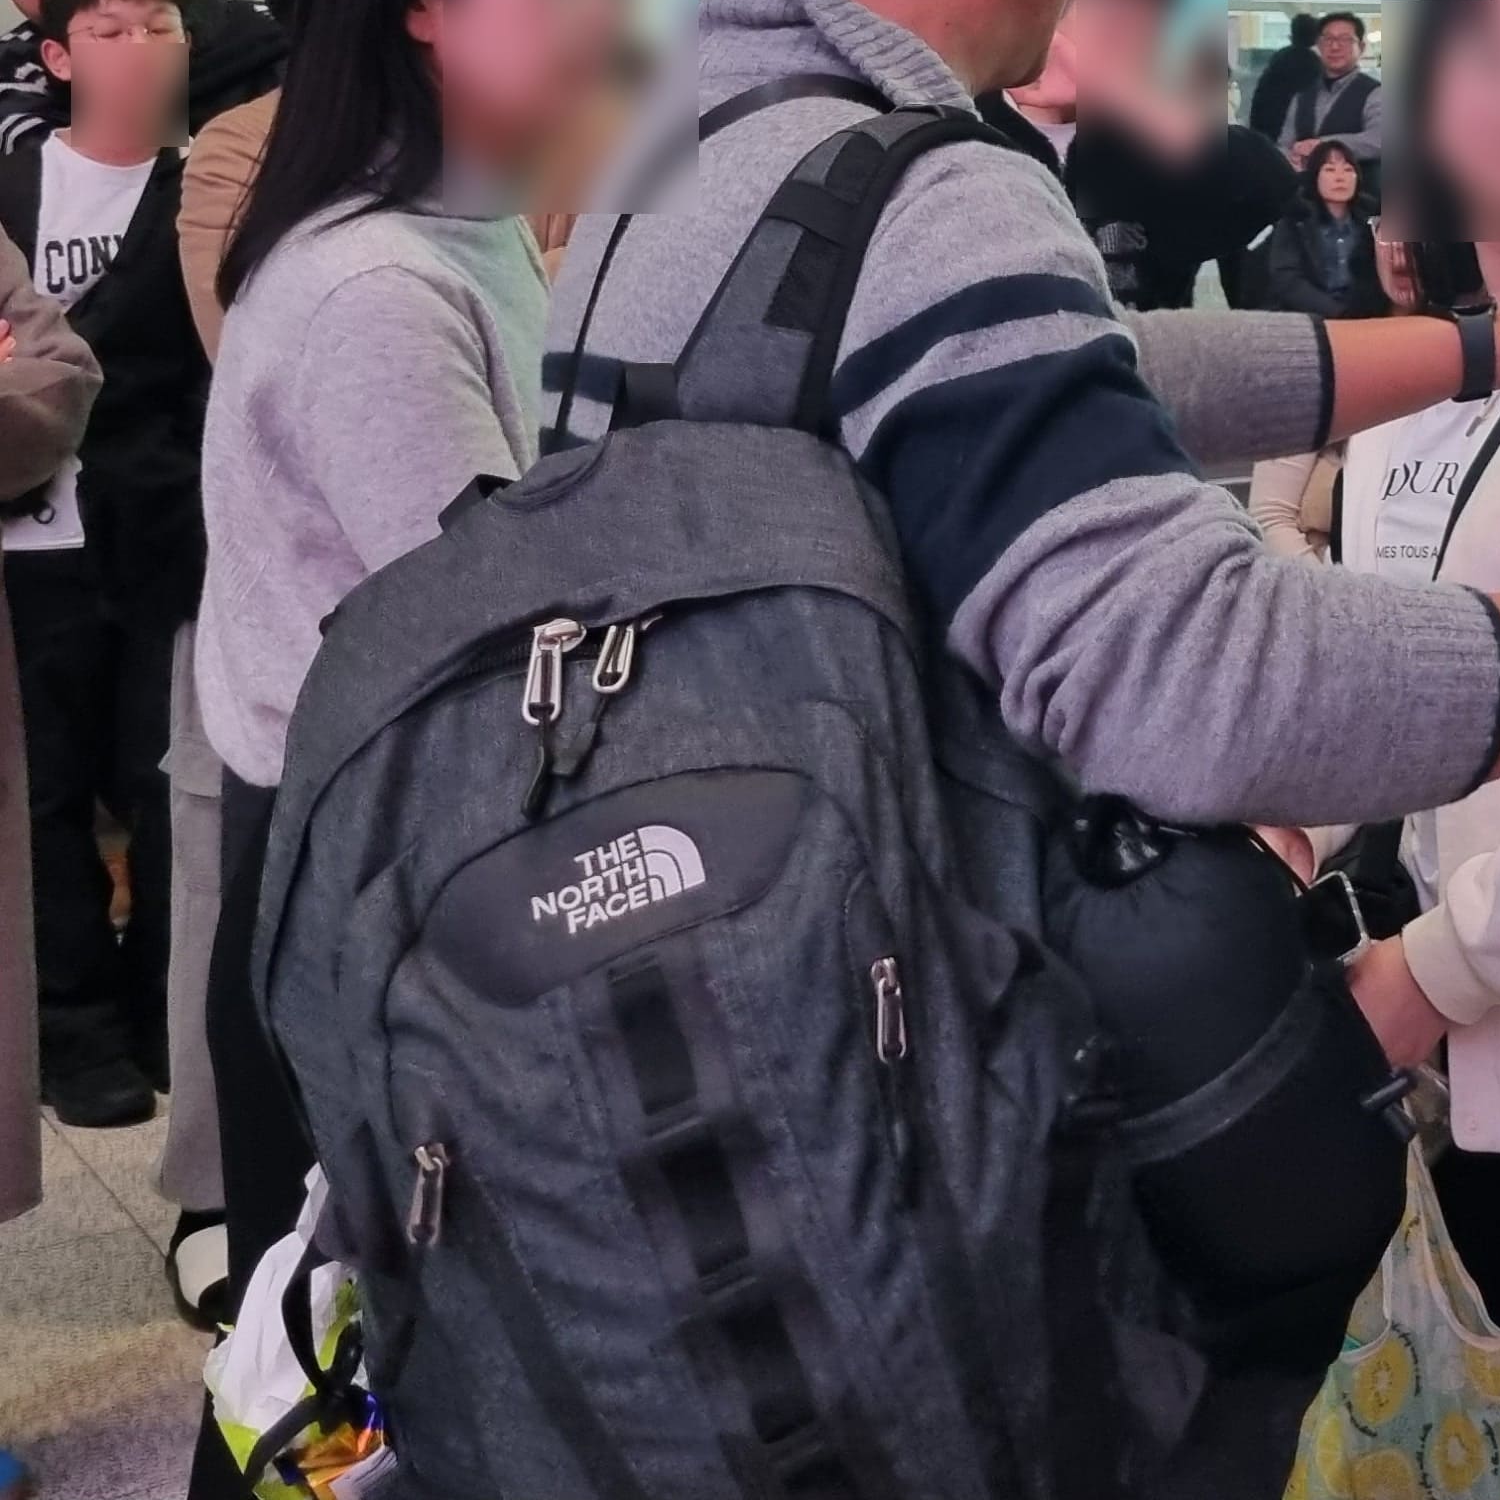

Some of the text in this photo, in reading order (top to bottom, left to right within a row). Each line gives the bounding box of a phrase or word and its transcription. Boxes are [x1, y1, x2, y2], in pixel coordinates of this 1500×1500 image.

[1400, 545, 1429, 558] TOUS
[574, 832, 640, 877] THE
[530, 857, 648, 921] NORTH
[567, 883, 649, 934] FACE
